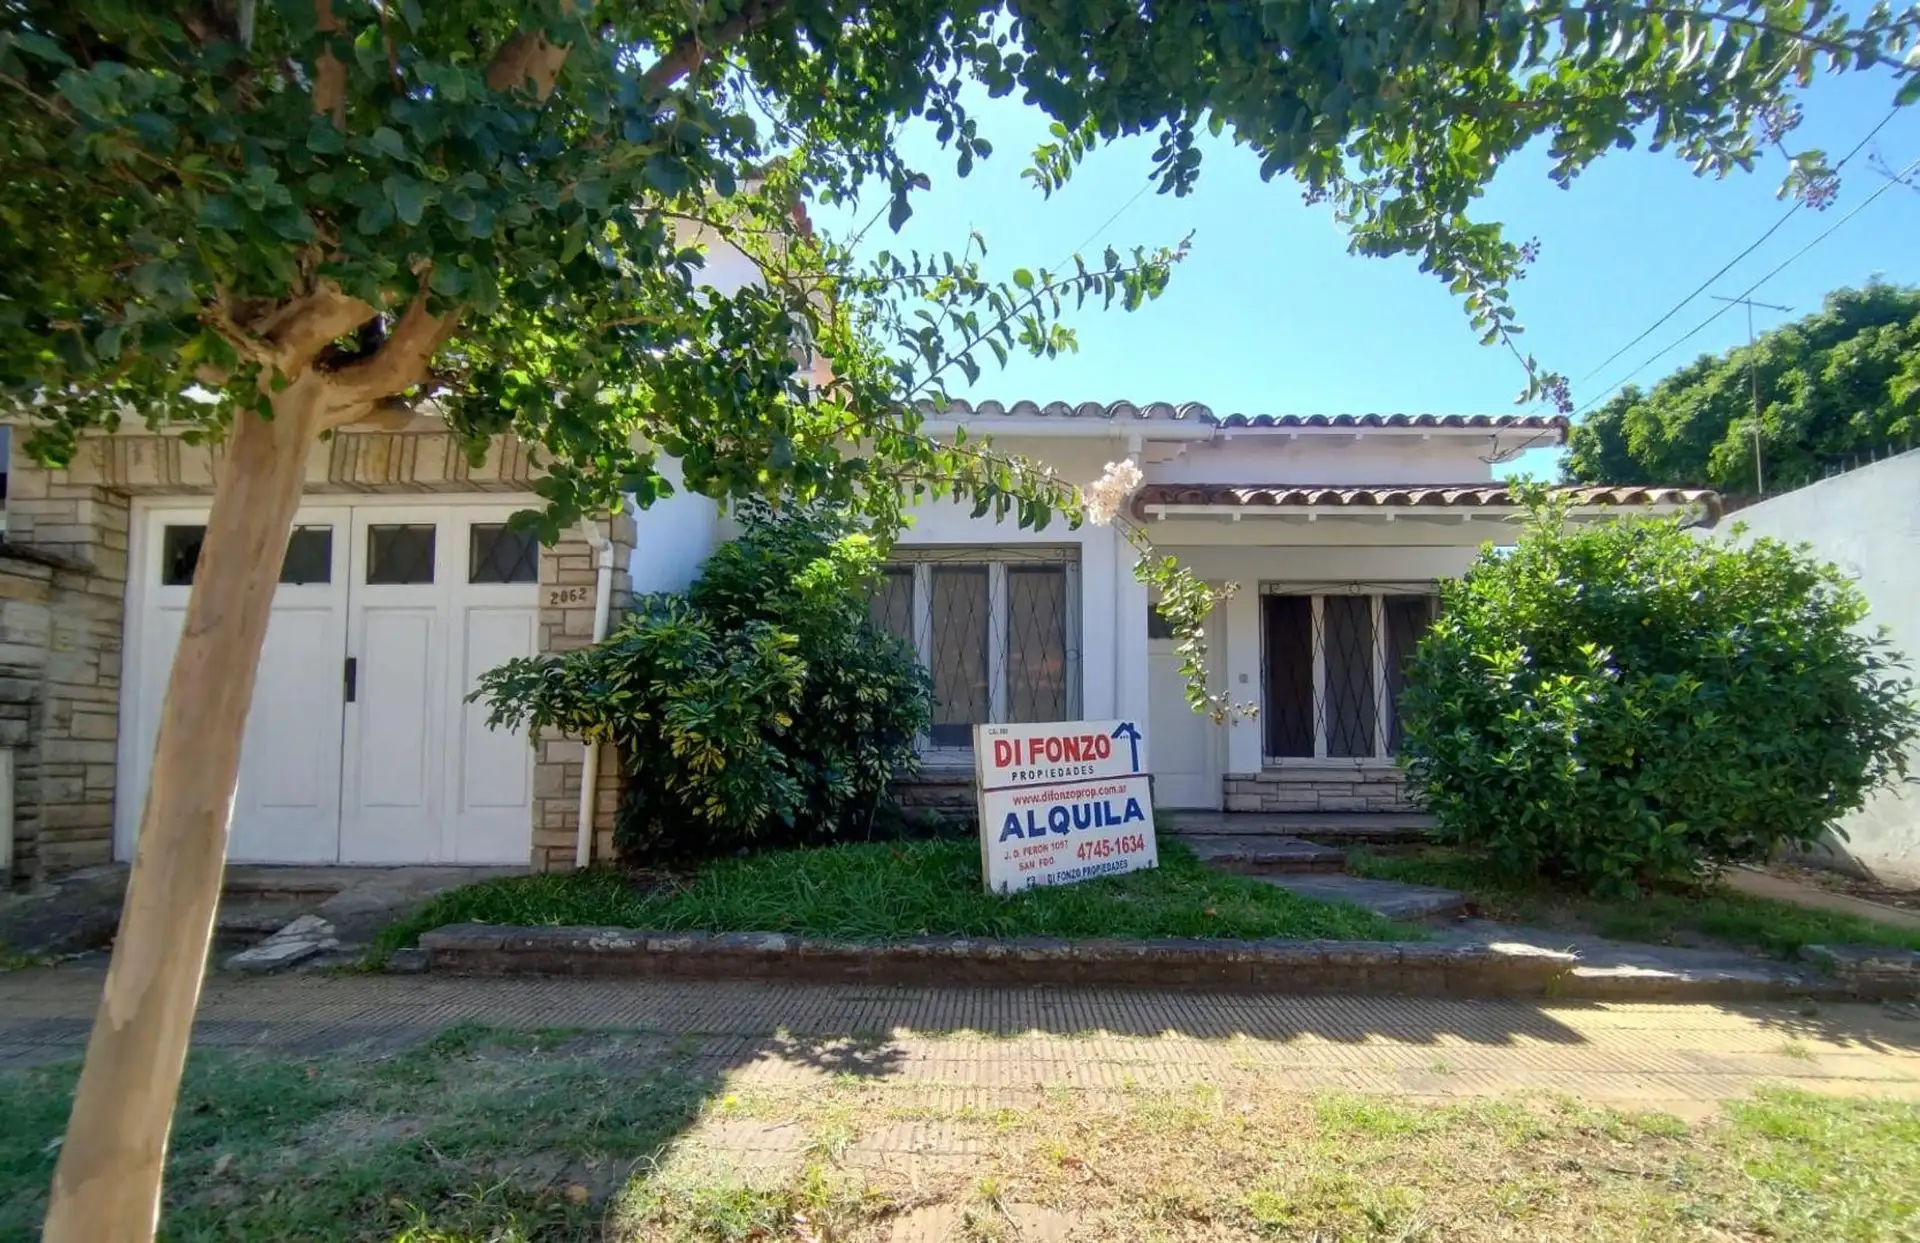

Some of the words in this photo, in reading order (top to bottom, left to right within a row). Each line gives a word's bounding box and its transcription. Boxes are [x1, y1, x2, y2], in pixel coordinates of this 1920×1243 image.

[550, 587, 587, 605] 2062
[994, 739, 1021, 768] DI
[1029, 734, 1111, 765] FONZO
[1012, 765, 1095, 781] PROPIEDADES
[1013, 784, 1127, 806] www.difonzoprop.com.ar
[999, 797, 1145, 843] ALQUILA
[1077, 834, 1145, 861] 4745-1634
[1019, 860, 1035, 872] SAN
[1047, 873, 1055, 884] DI
[1057, 867, 1081, 882] FONZO
[1082, 859, 1128, 877] PROPIEDADES
